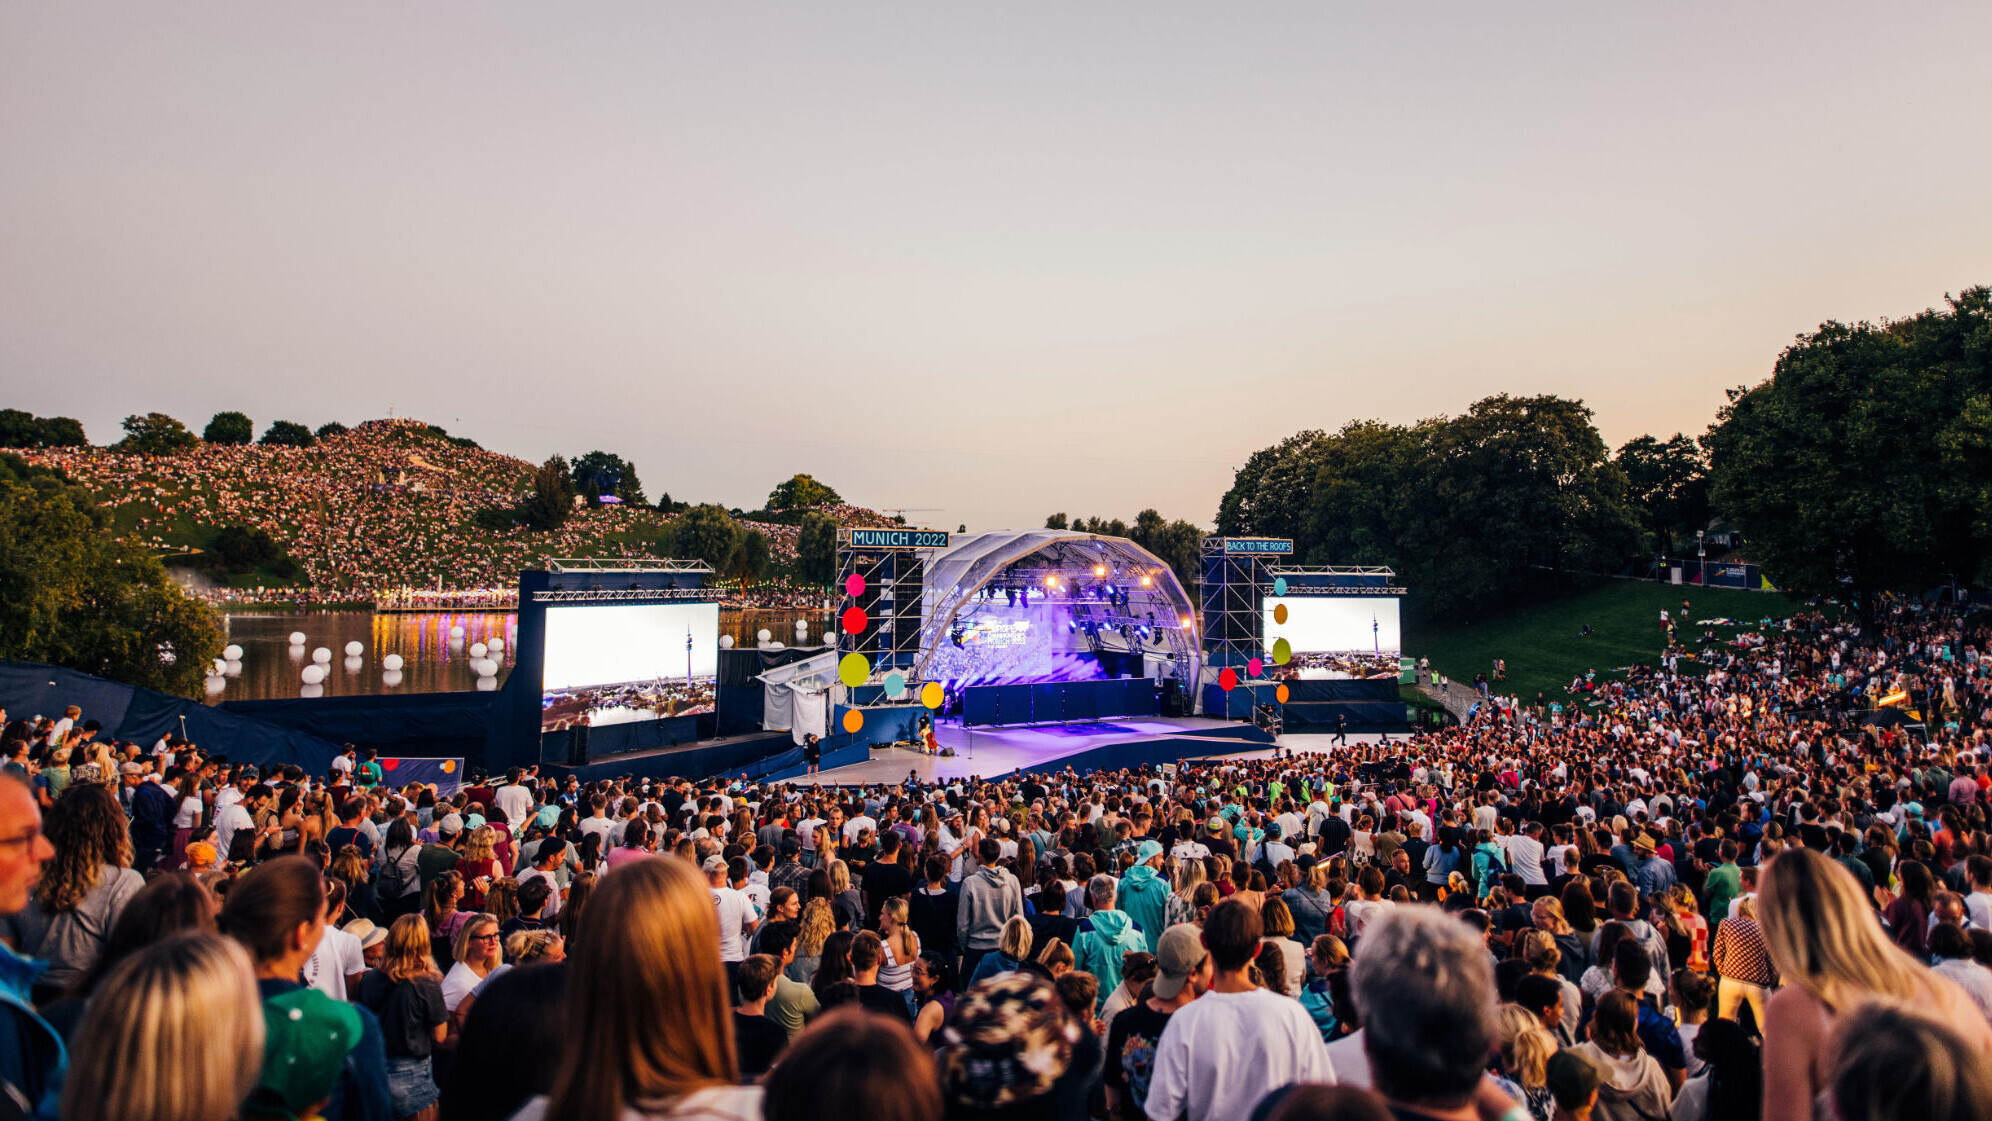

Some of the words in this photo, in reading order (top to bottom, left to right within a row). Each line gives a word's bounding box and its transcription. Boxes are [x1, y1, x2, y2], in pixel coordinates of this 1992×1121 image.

[854, 532, 909, 545] MUNICH
[915, 533, 946, 546] 2022
[1227, 541, 1245, 551] BACK
[1246, 542, 1255, 551] TO
[1256, 542, 1269, 551] THE
[1270, 542, 1291, 551] ROOFS
